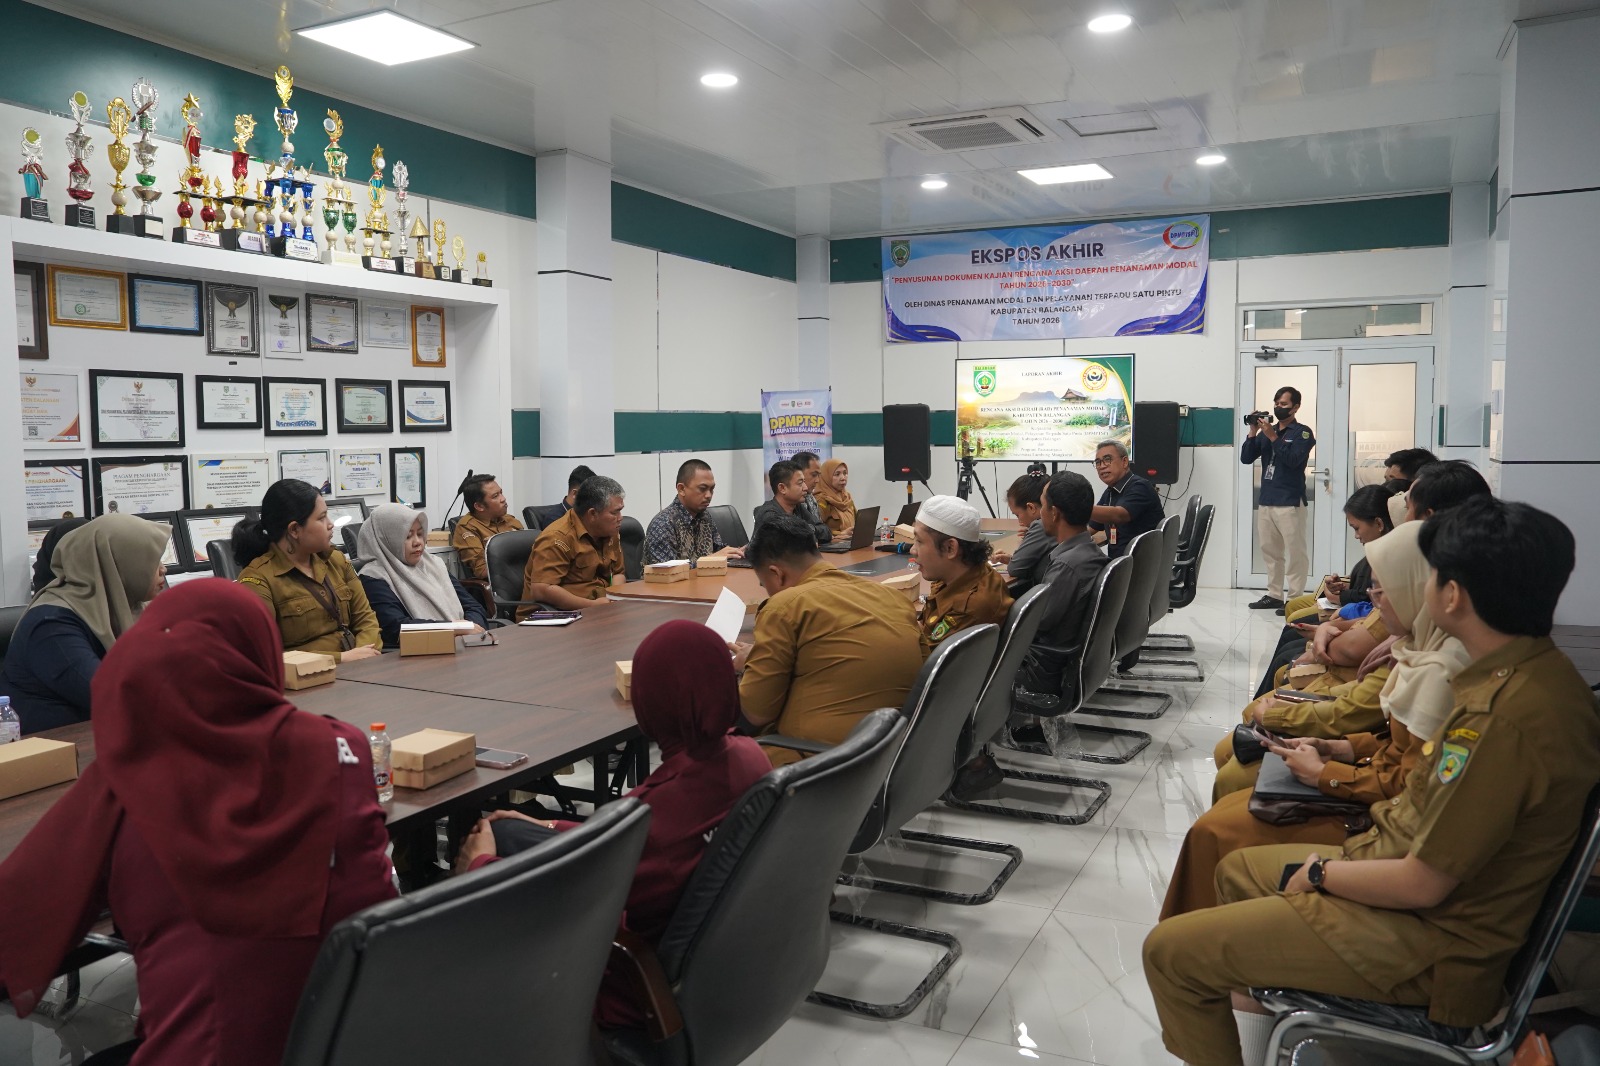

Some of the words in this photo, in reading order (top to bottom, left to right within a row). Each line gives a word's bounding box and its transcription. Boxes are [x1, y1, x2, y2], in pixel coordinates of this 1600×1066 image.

[971, 246, 1042, 264] EKSPOS
[1045, 242, 1104, 260] AKHIR
[944, 273, 983, 281] DOKUMEN
[984, 271, 1013, 279] KAJIAN
[1014, 269, 1053, 278] RENCANA
[1055, 267, 1074, 276] AKSI
[1075, 266, 1109, 275] DAERAH
[1110, 262, 1164, 273] PENANAMAN
[1166, 260, 1198, 269] MODAL
[1000, 281, 1027, 289] TAHUN
[904, 300, 923, 308] OLEH
[923, 299, 946, 307] DINAS
[947, 298, 996, 306] PENANAMAN
[997, 296, 1024, 304] MODAL
[1045, 293, 1093, 302] PELAYANAN
[1094, 291, 1131, 300] TERPADU
[1132, 290, 1155, 298] SATU
[1156, 288, 1182, 297] PINTU
[990, 307, 1037, 316] KABUPATEN
[1038, 305, 1083, 313] BALANGAN
[769, 414, 825, 430] DPMPTSP
[770, 427, 799, 435] KABUPATEN
